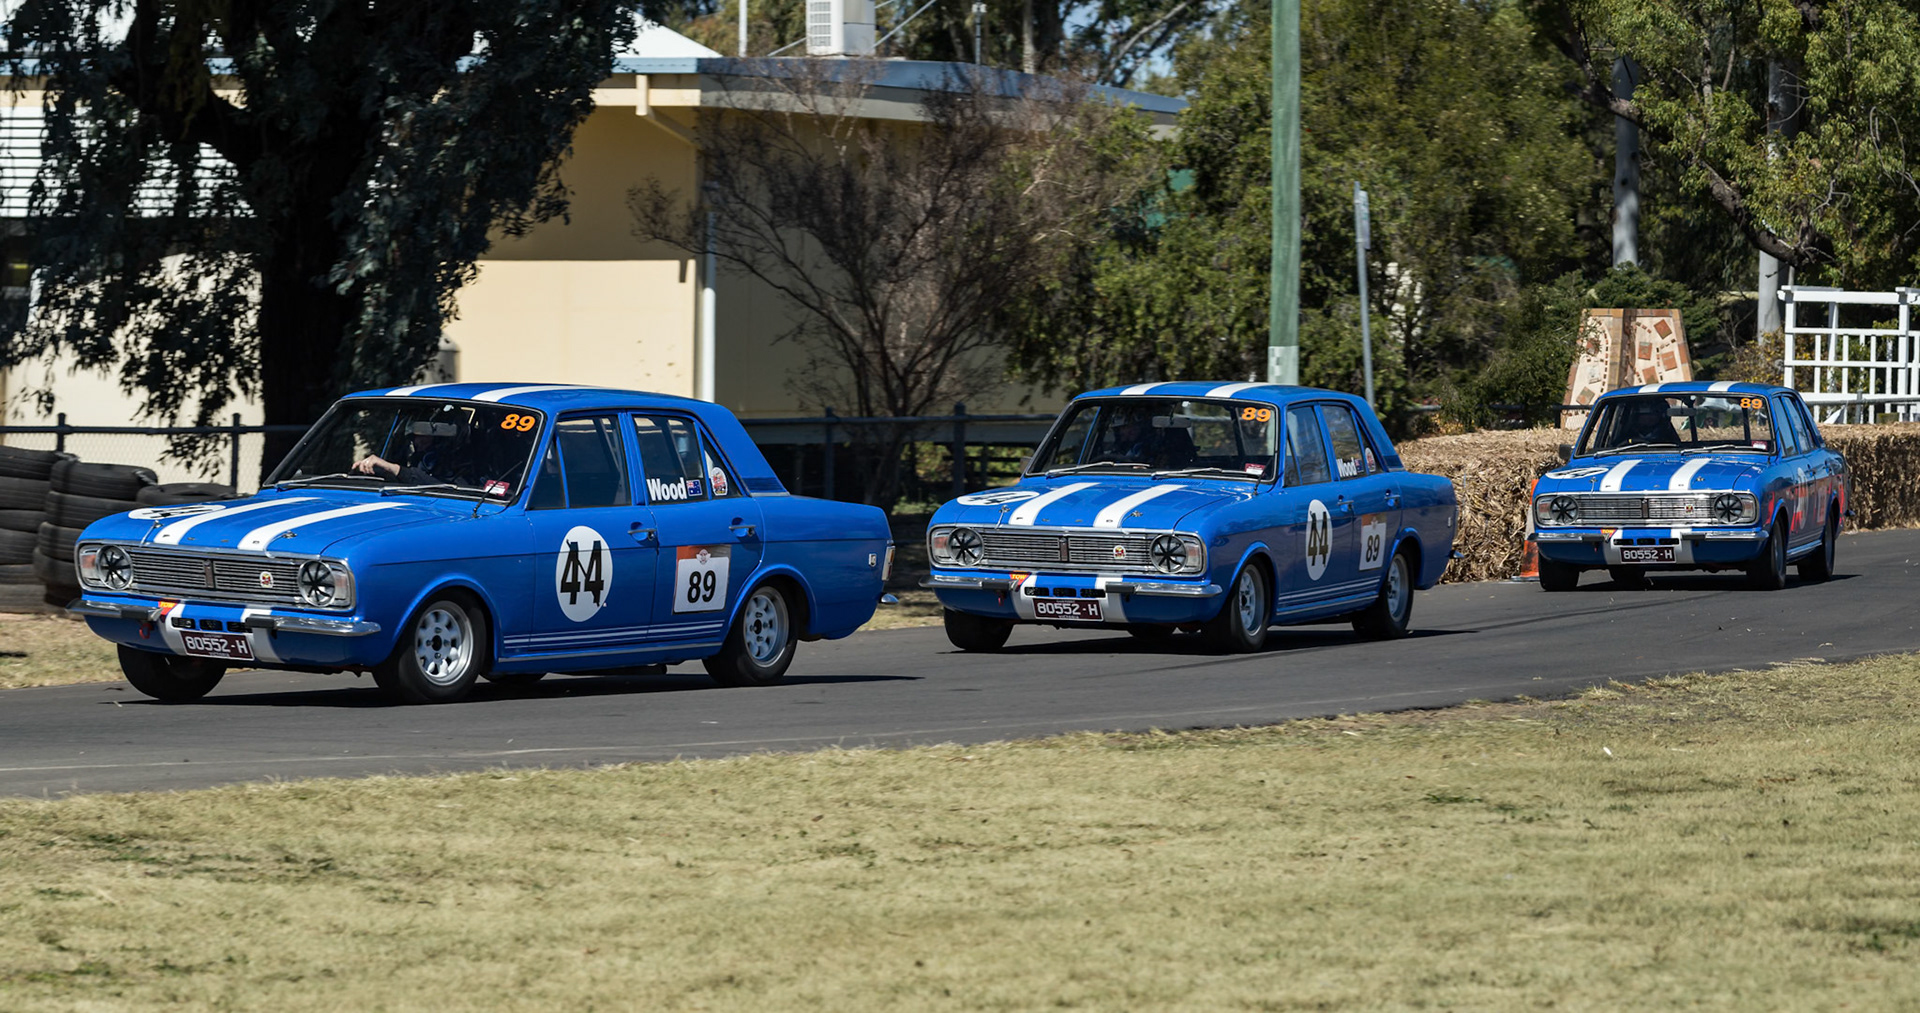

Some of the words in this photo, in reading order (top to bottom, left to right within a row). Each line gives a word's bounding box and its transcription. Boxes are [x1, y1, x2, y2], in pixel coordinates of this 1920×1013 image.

[1740, 398, 1763, 409] 89
[501, 413, 536, 432] 89
[1241, 407, 1271, 422] 89
[1336, 457, 1358, 478] Wood
[646, 477, 687, 501] Wood
[1308, 511, 1329, 568] 44
[1366, 534, 1380, 563] 89
[560, 539, 604, 607] 44
[687, 570, 716, 603] 89
[1037, 603, 1099, 615] 80552-H
[185, 636, 249, 654] 80552-H
